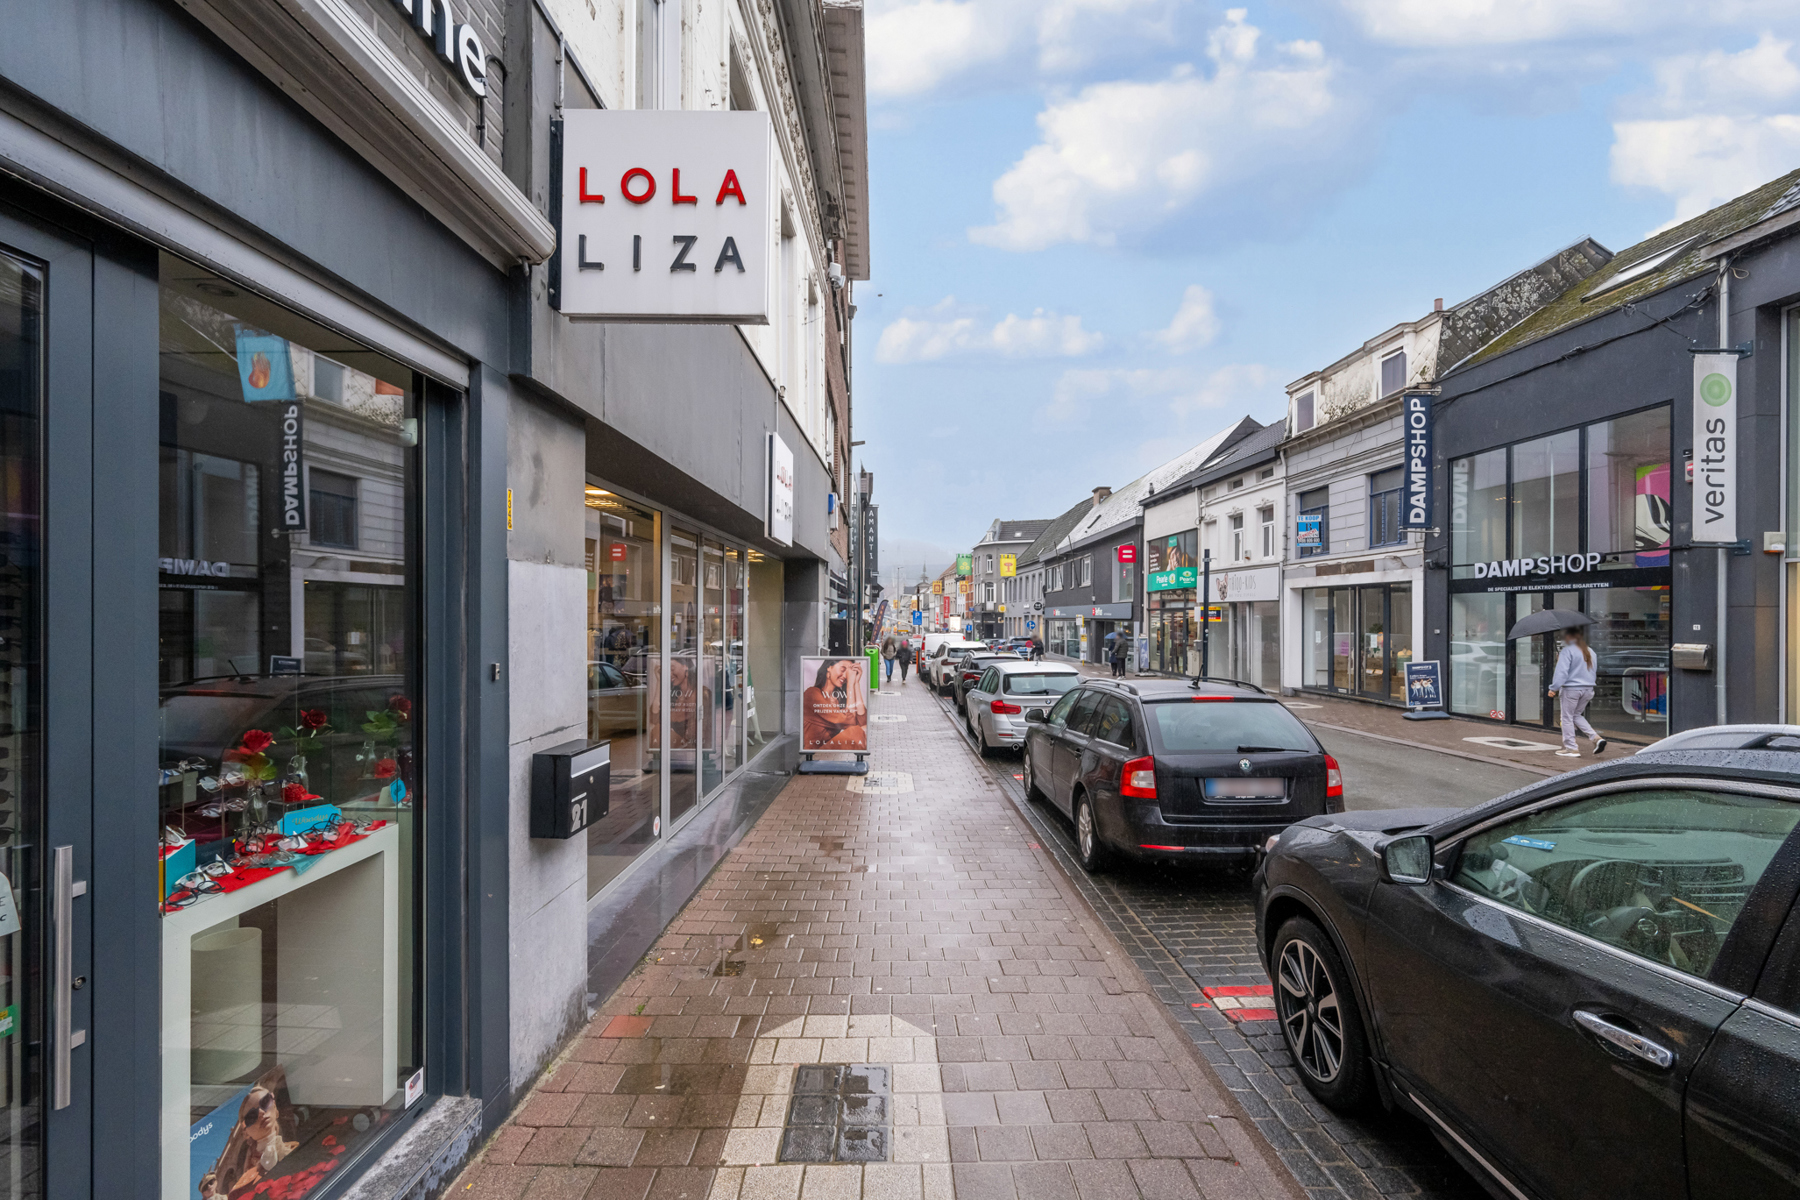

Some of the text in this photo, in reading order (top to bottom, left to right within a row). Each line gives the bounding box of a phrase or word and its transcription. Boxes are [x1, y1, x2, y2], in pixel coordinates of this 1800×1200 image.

[579, 167, 747, 205] LOLA
[578, 234, 746, 273] LIZA
[1409, 398, 1427, 524] DAMPSHOP
[1701, 418, 1726, 525] veritas
[1474, 552, 1601, 579] DAMPSHOP
[571, 799, 588, 832] 21
